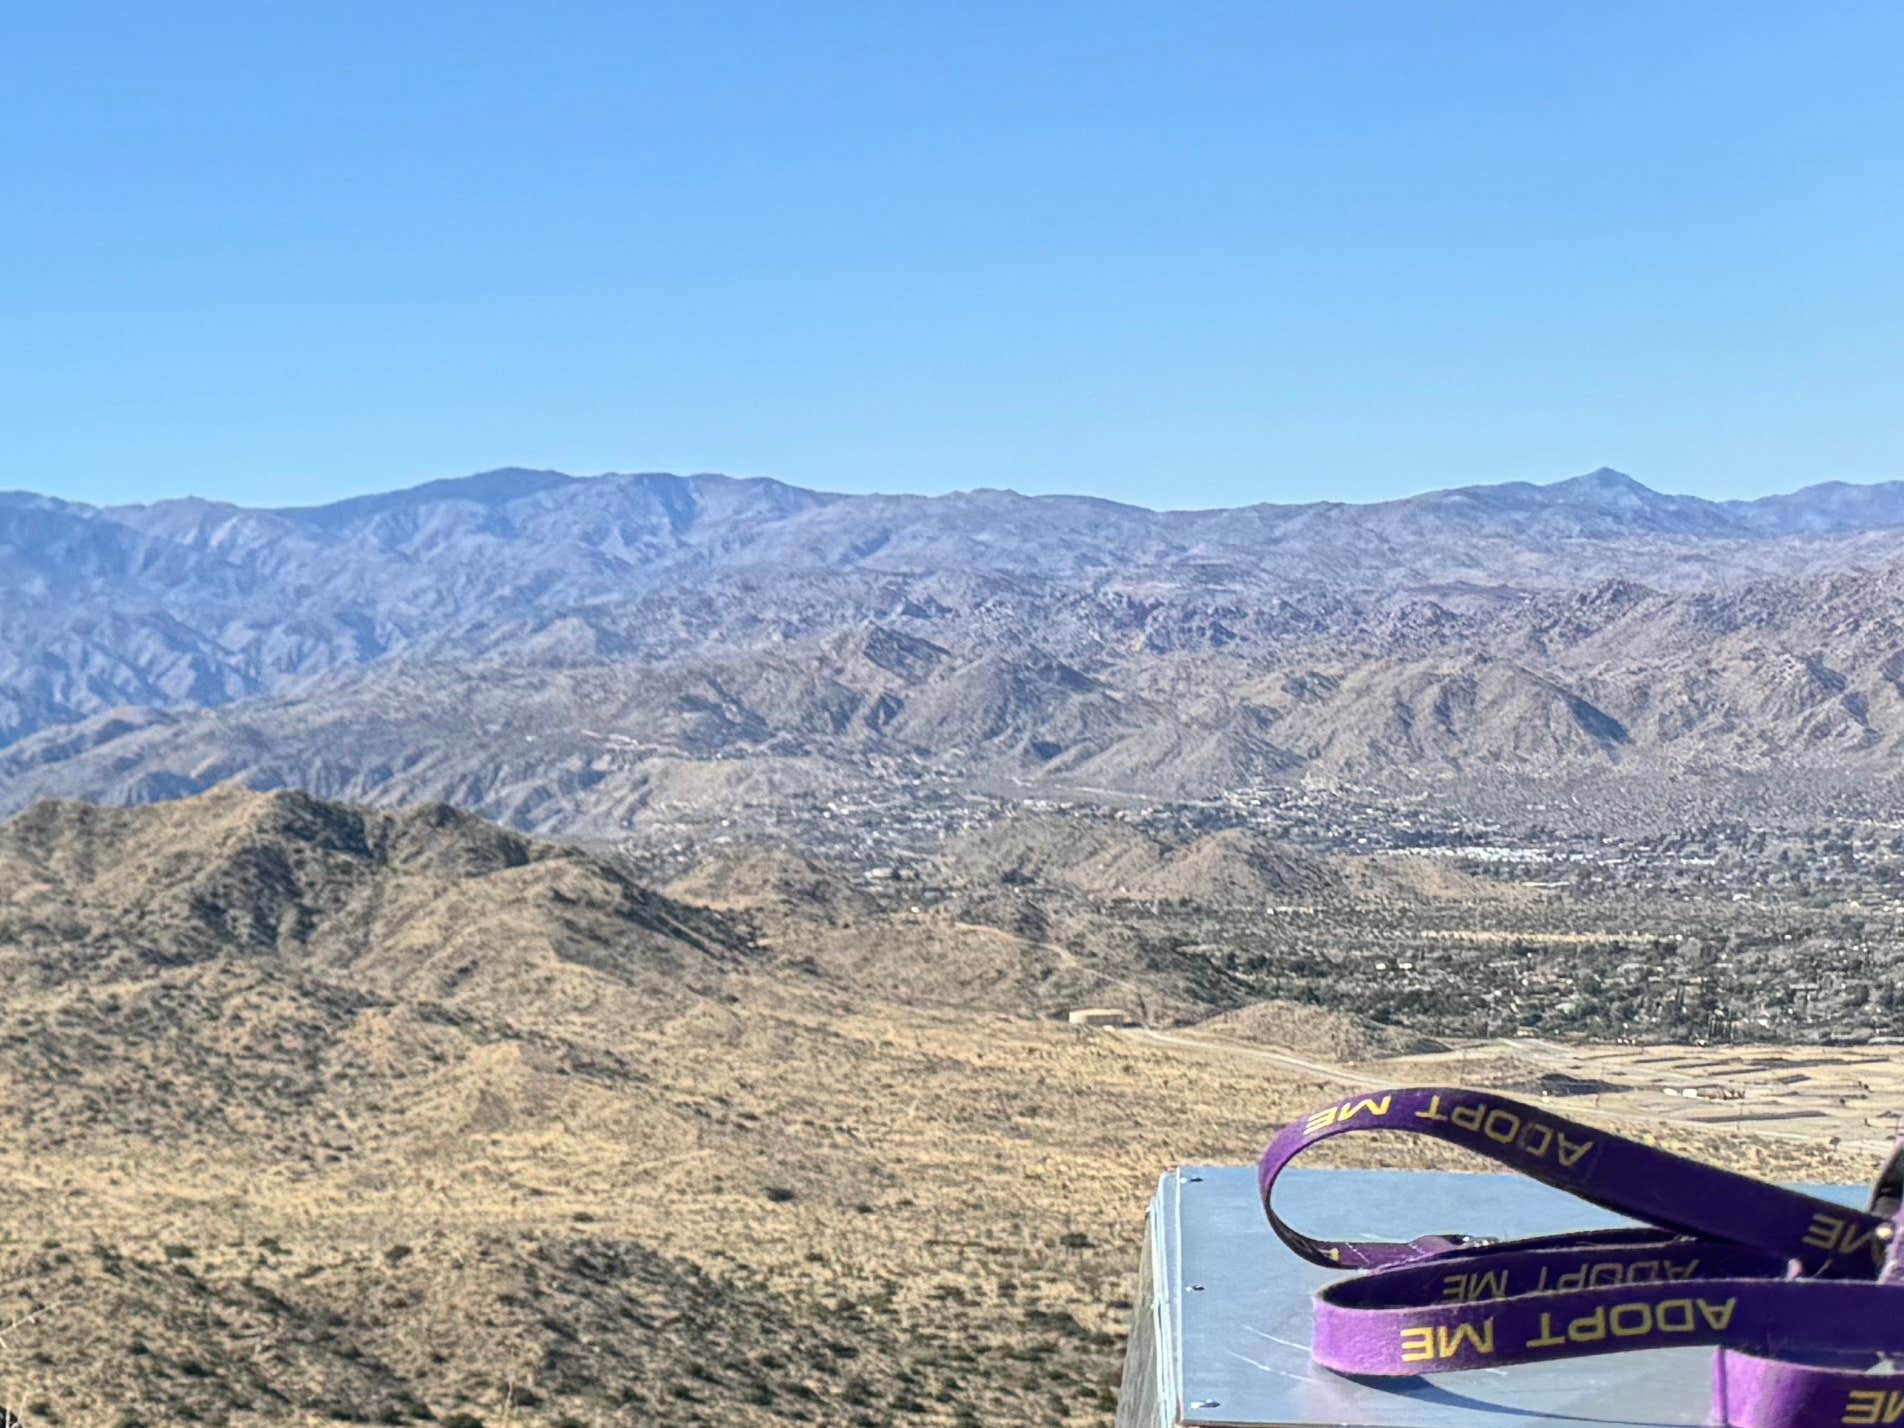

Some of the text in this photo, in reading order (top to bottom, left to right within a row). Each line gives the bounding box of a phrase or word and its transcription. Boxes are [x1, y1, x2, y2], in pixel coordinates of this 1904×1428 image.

[1303, 1095, 1593, 1167] ADOPT ME
[1400, 1297, 1737, 1362] ADOPT ME
